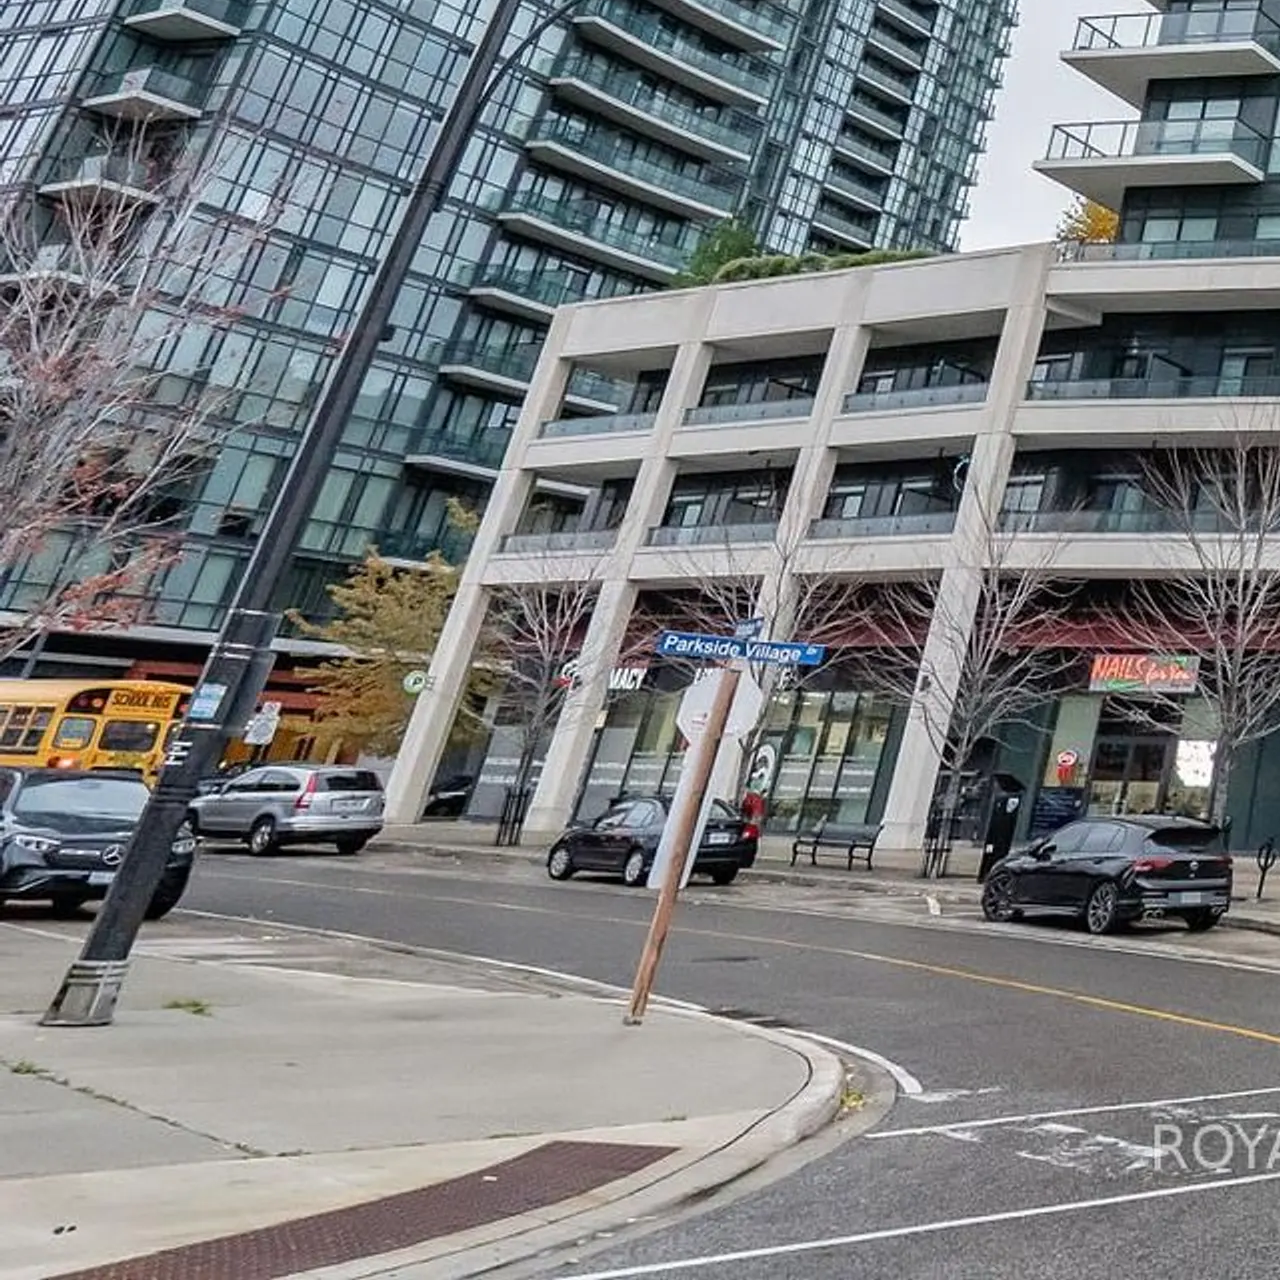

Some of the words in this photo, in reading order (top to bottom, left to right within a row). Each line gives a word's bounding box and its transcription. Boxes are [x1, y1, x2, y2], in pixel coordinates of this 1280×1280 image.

[664, 635, 740, 658] Parkside
[746, 642, 801, 662] Village
[1092, 657, 1147, 679] NAILS
[112, 691, 152, 707] SCHOOL
